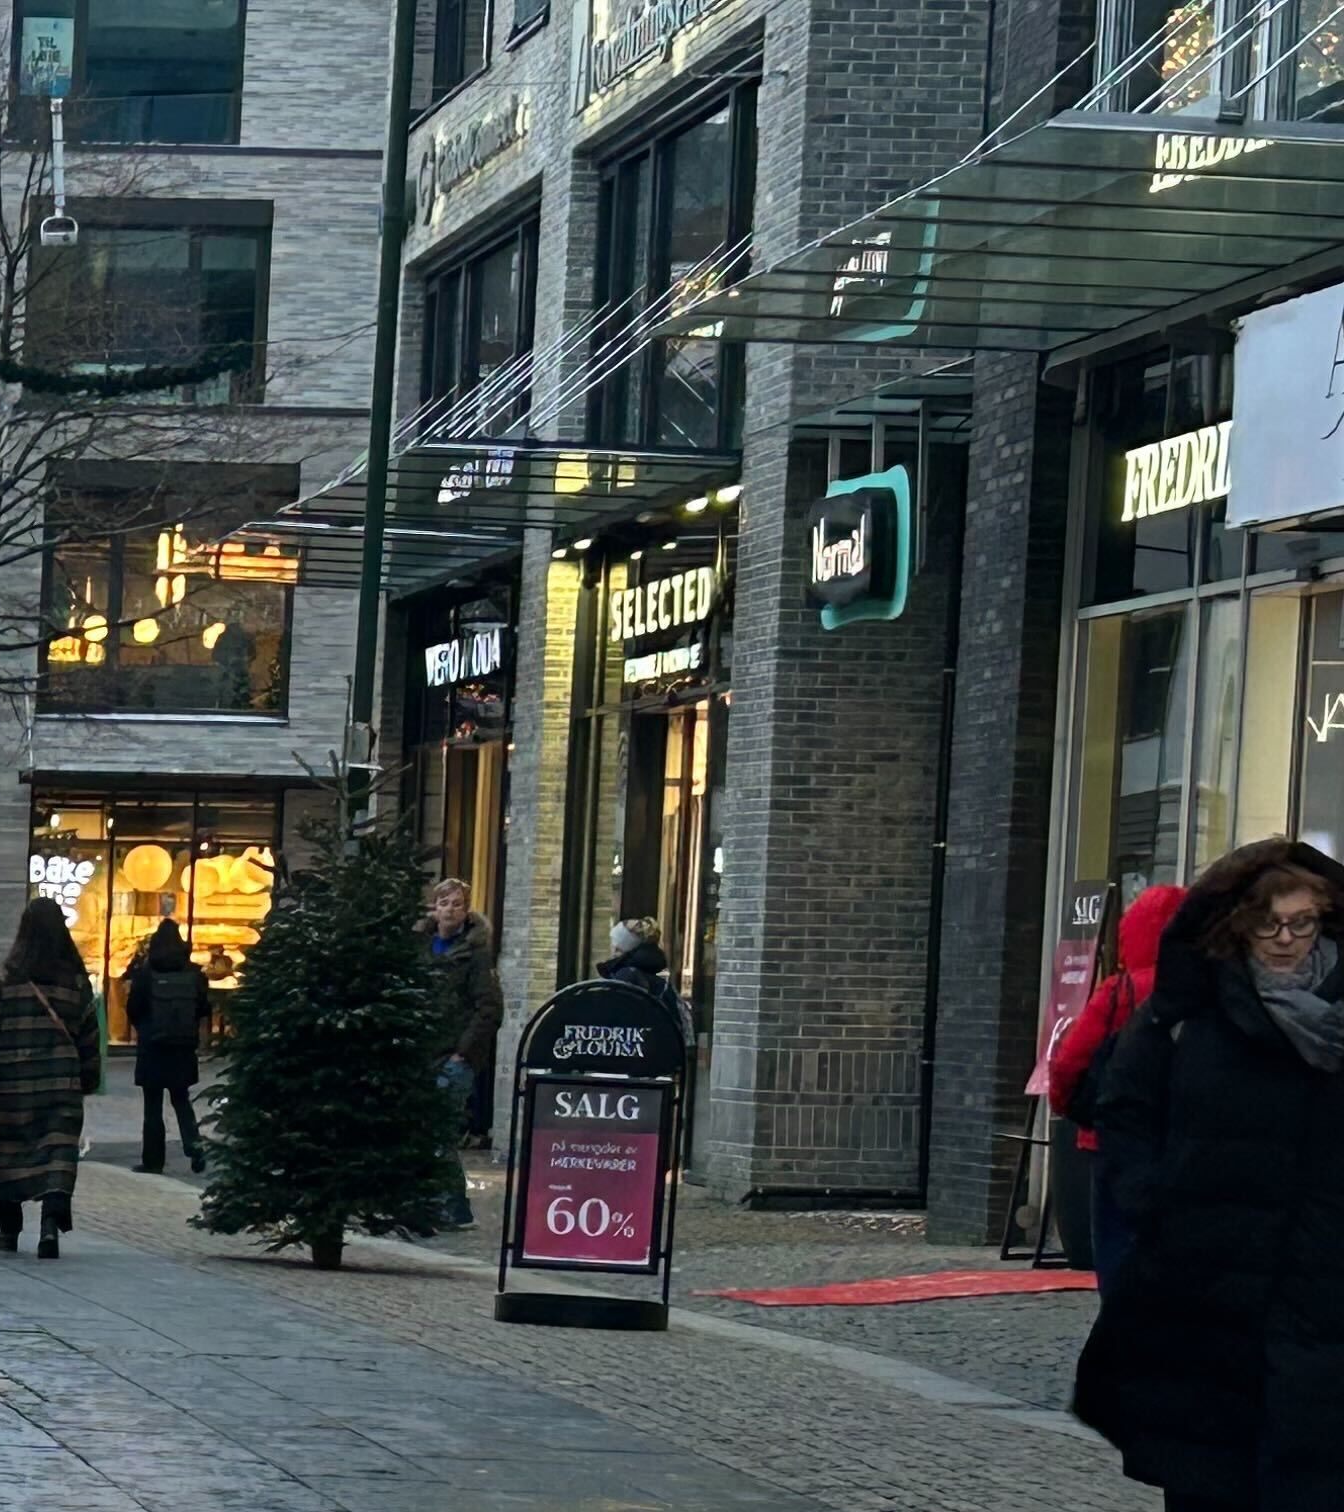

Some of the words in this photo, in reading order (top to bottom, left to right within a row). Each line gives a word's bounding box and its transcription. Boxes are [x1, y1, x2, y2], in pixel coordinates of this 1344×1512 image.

[612, 566, 713, 642] SELECTED
[30, 854, 95, 884] Bake
[564, 1025, 645, 1042] FREDRIK
[554, 1092, 640, 1120] SALG
[546, 1196, 635, 1238] 60%
